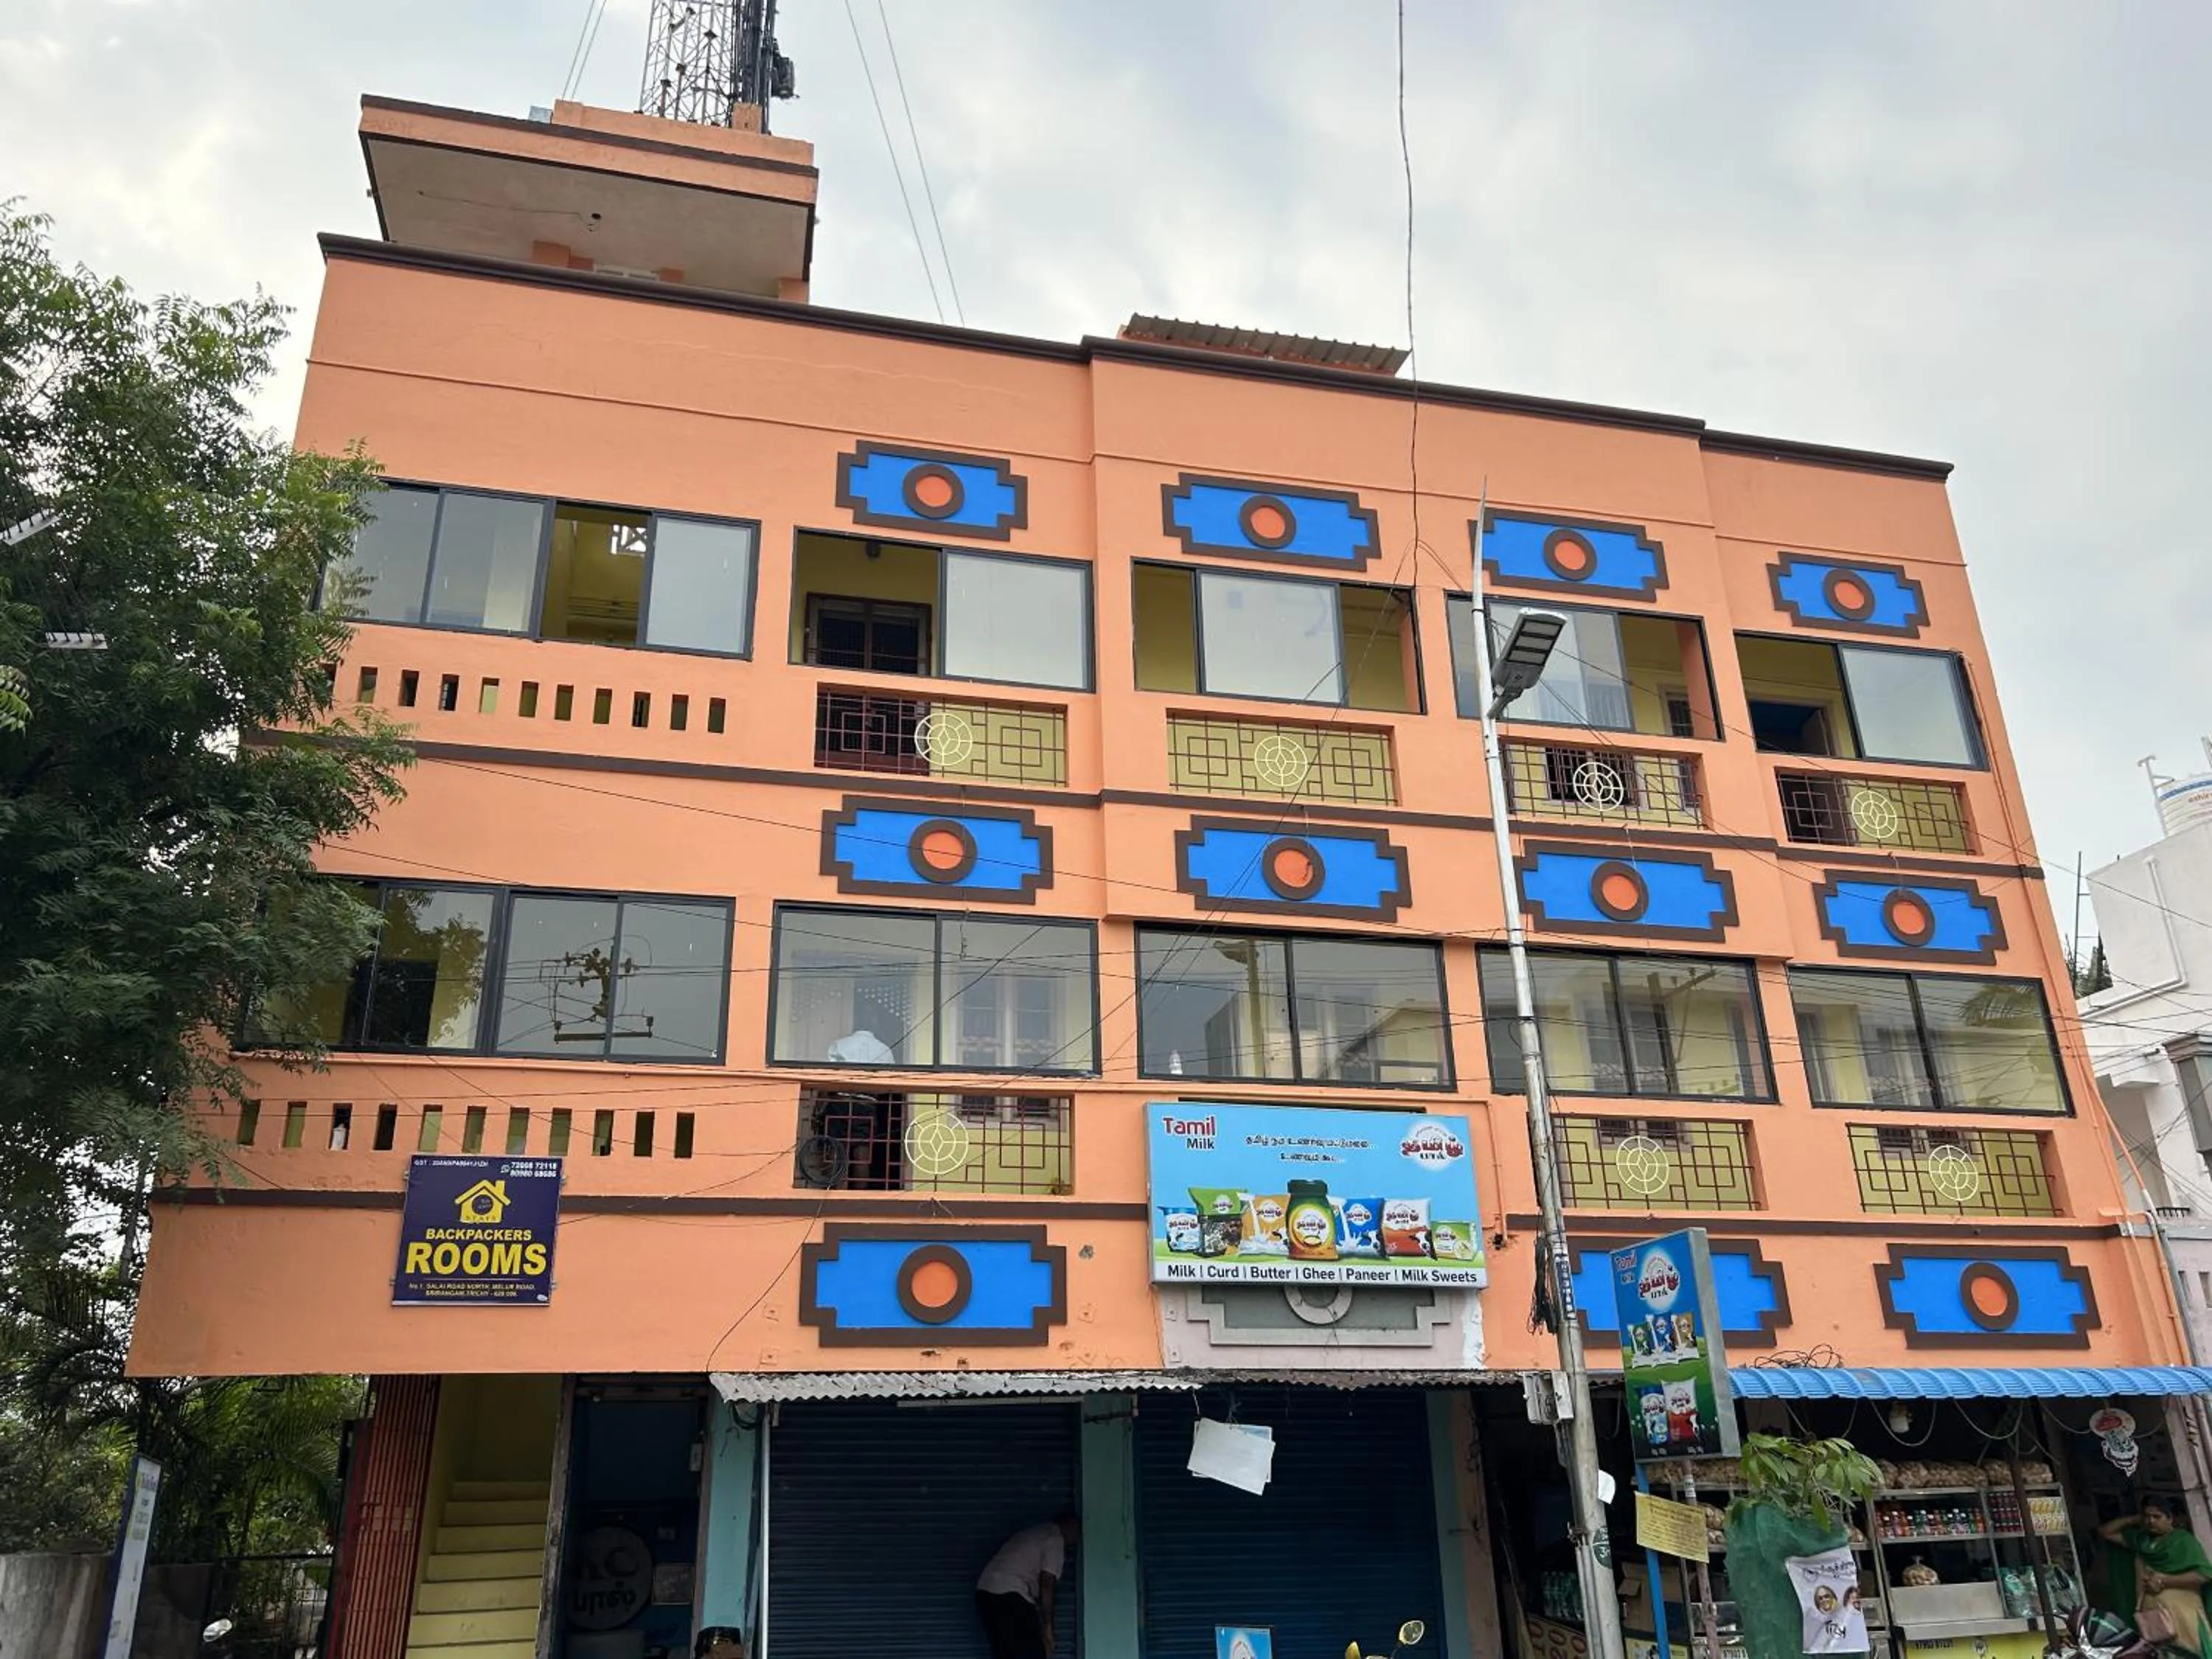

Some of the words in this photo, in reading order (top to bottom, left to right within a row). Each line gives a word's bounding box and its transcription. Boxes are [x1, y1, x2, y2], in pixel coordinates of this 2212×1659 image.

[1163, 1116, 1216, 1136] Tamil
[1186, 1138, 1215, 1150] Milk
[425, 1228, 532, 1242] BACKPACKERS
[405, 1242, 548, 1276] ROOMS
[1167, 1264, 1196, 1278] Milk
[1206, 1265, 1239, 1279] Curd
[1250, 1266, 1291, 1279] Butter
[1302, 1267, 1335, 1280] Ghee
[1345, 1267, 1391, 1281] Paneer
[1401, 1269, 1429, 1282] Milk
[1431, 1270, 1478, 1283] Sweets
